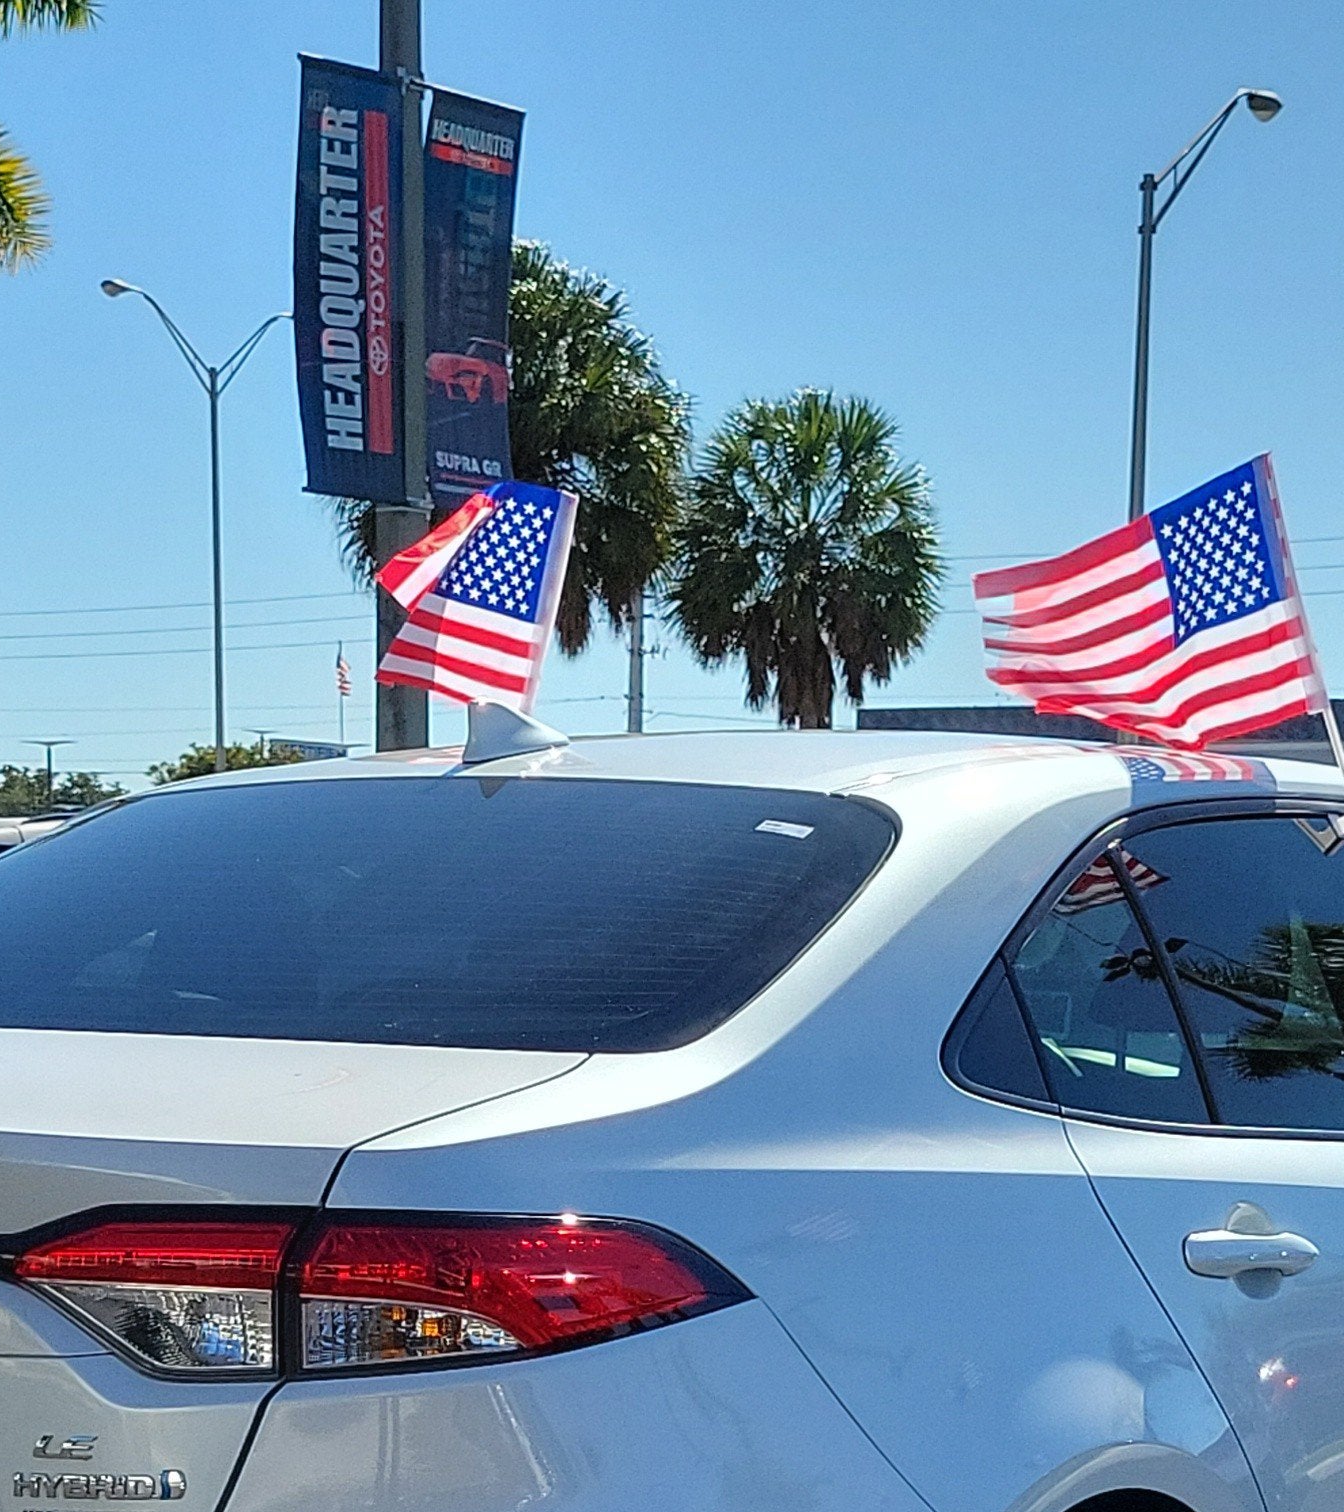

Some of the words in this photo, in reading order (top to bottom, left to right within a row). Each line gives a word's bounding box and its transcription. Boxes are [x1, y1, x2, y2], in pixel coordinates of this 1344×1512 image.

[320, 105, 365, 452] HEADQUARTER
[369, 205, 386, 334] TOYOTA
[436, 450, 481, 474] SUPRA
[482, 458, 502, 478] GR
[33, 1435, 98, 1461] LE
[13, 1471, 154, 1500] HYBRID
